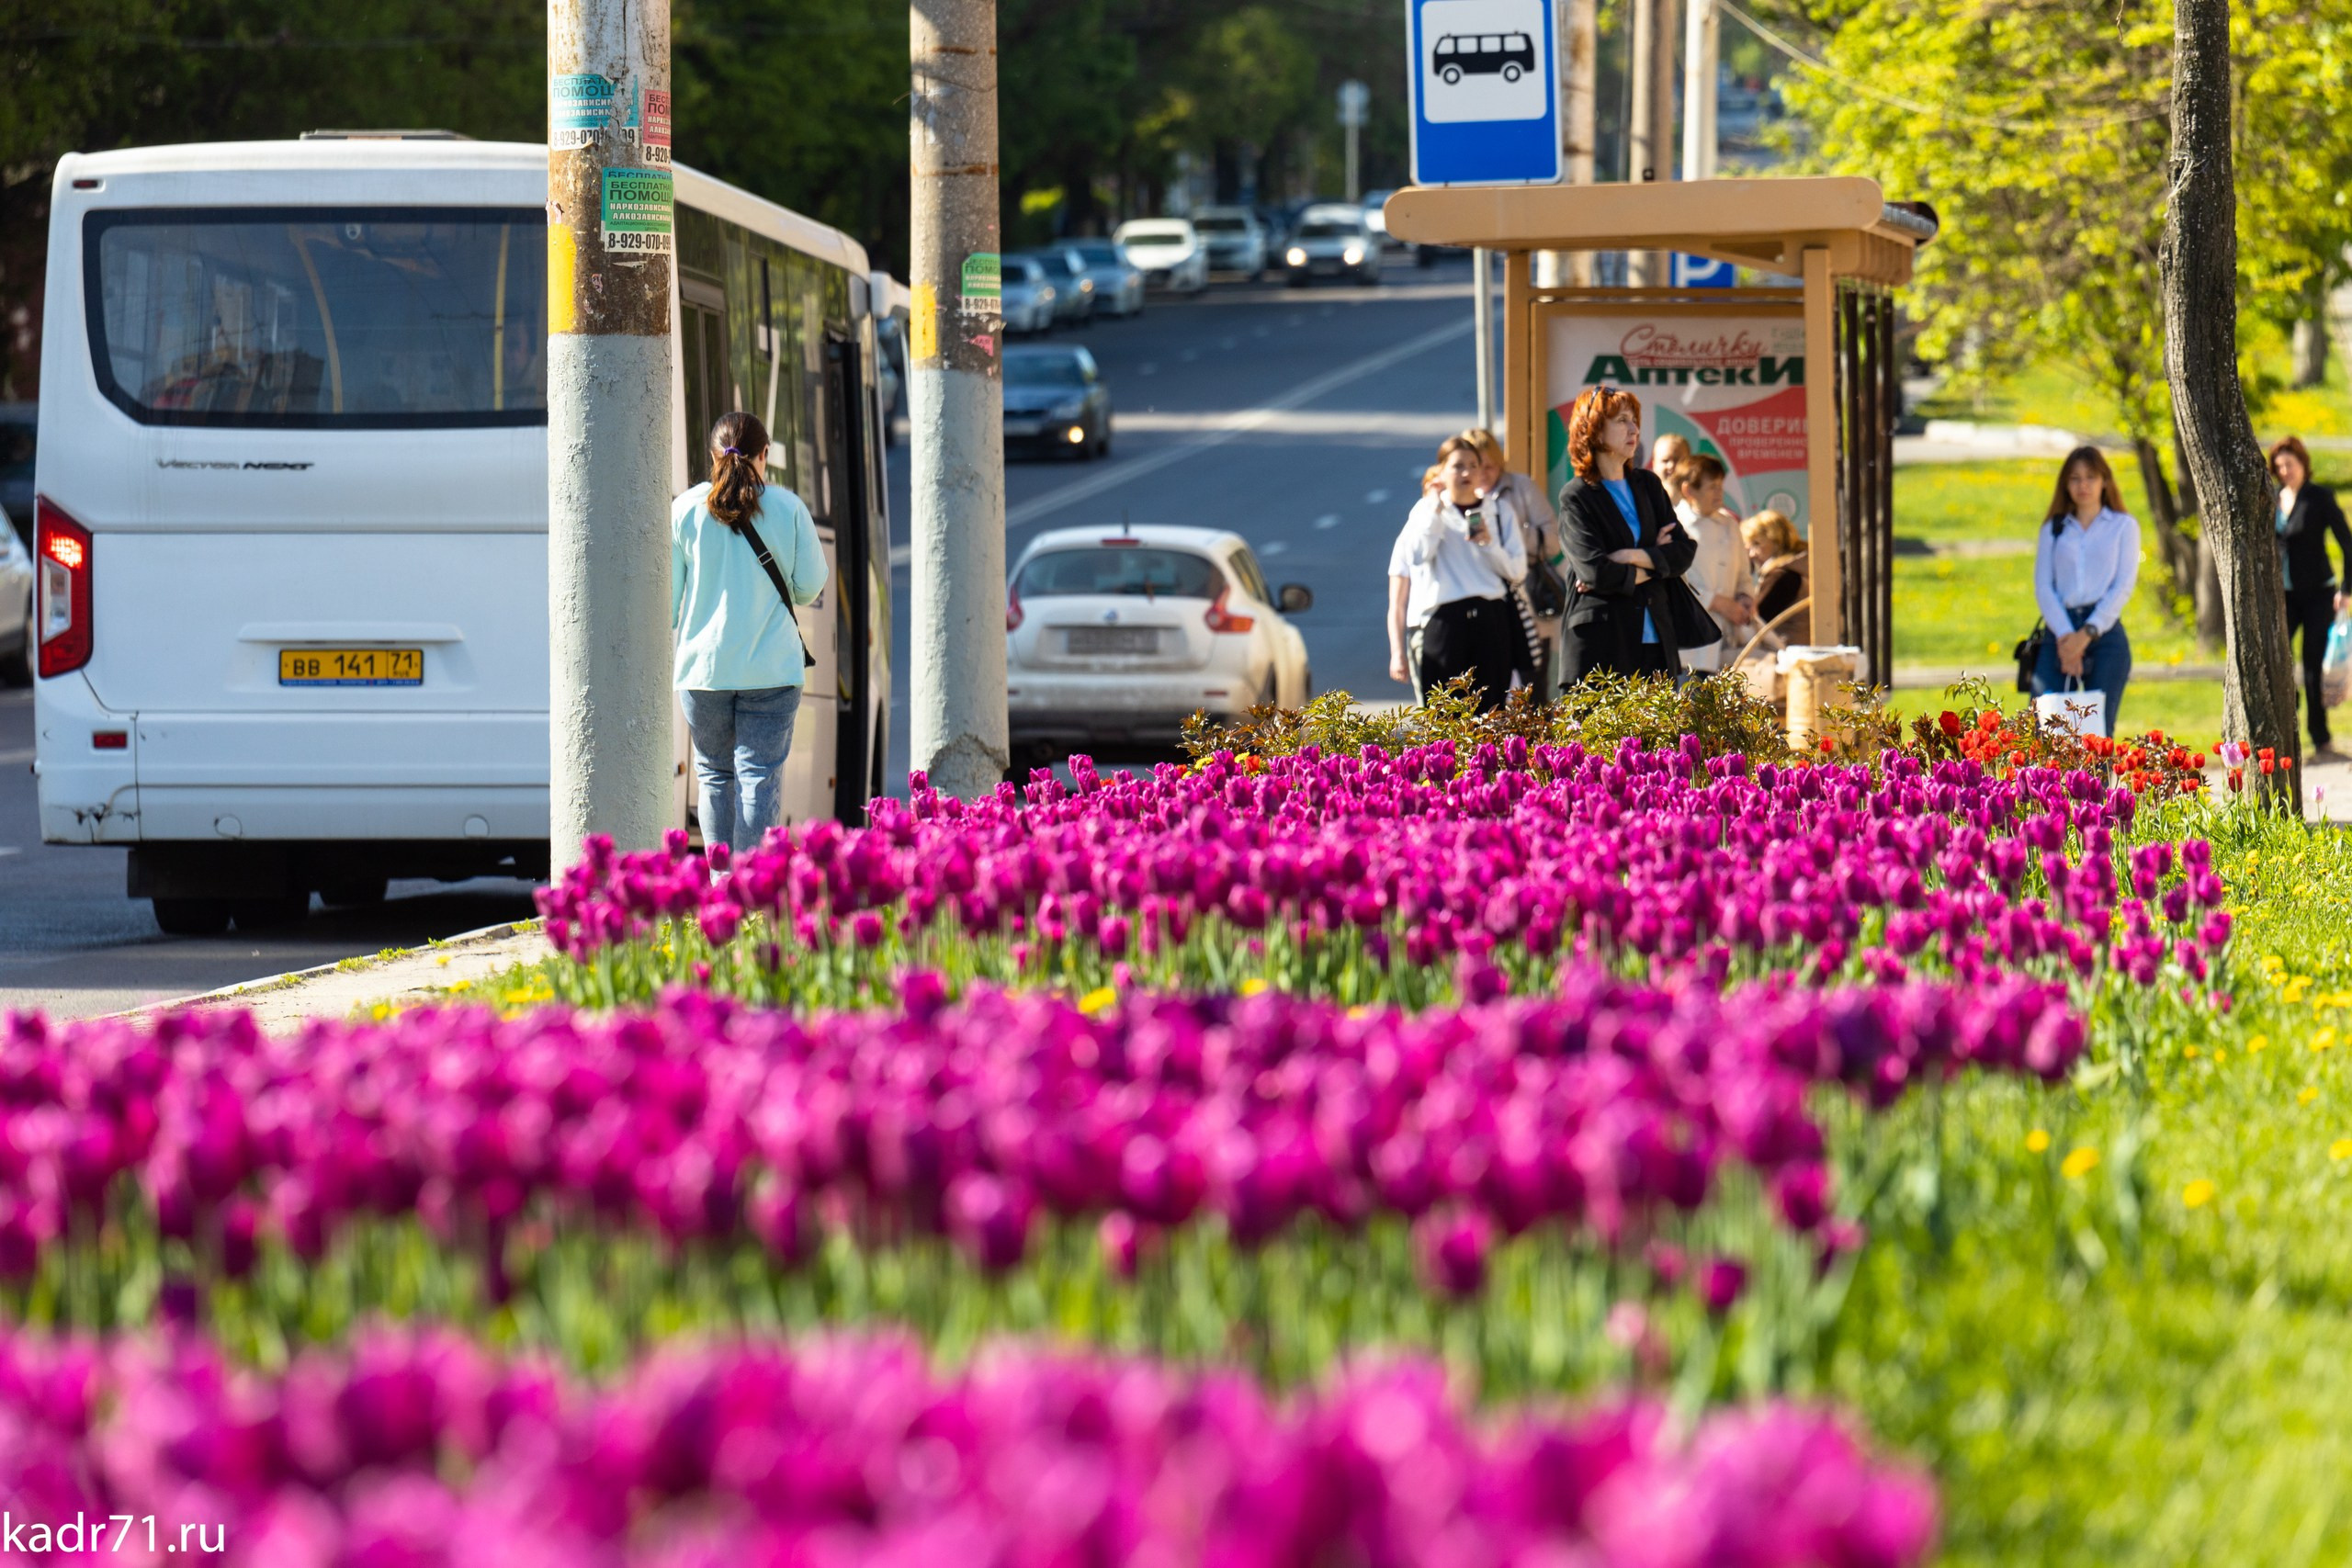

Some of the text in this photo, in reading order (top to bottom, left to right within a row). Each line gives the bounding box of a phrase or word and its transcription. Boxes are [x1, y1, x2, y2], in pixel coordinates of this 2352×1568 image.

[553, 85, 615, 98] ПОМОЩ
[334, 653, 376, 676] 141
[390, 652, 413, 670] 71
[392, 670, 411, 678] RUS
